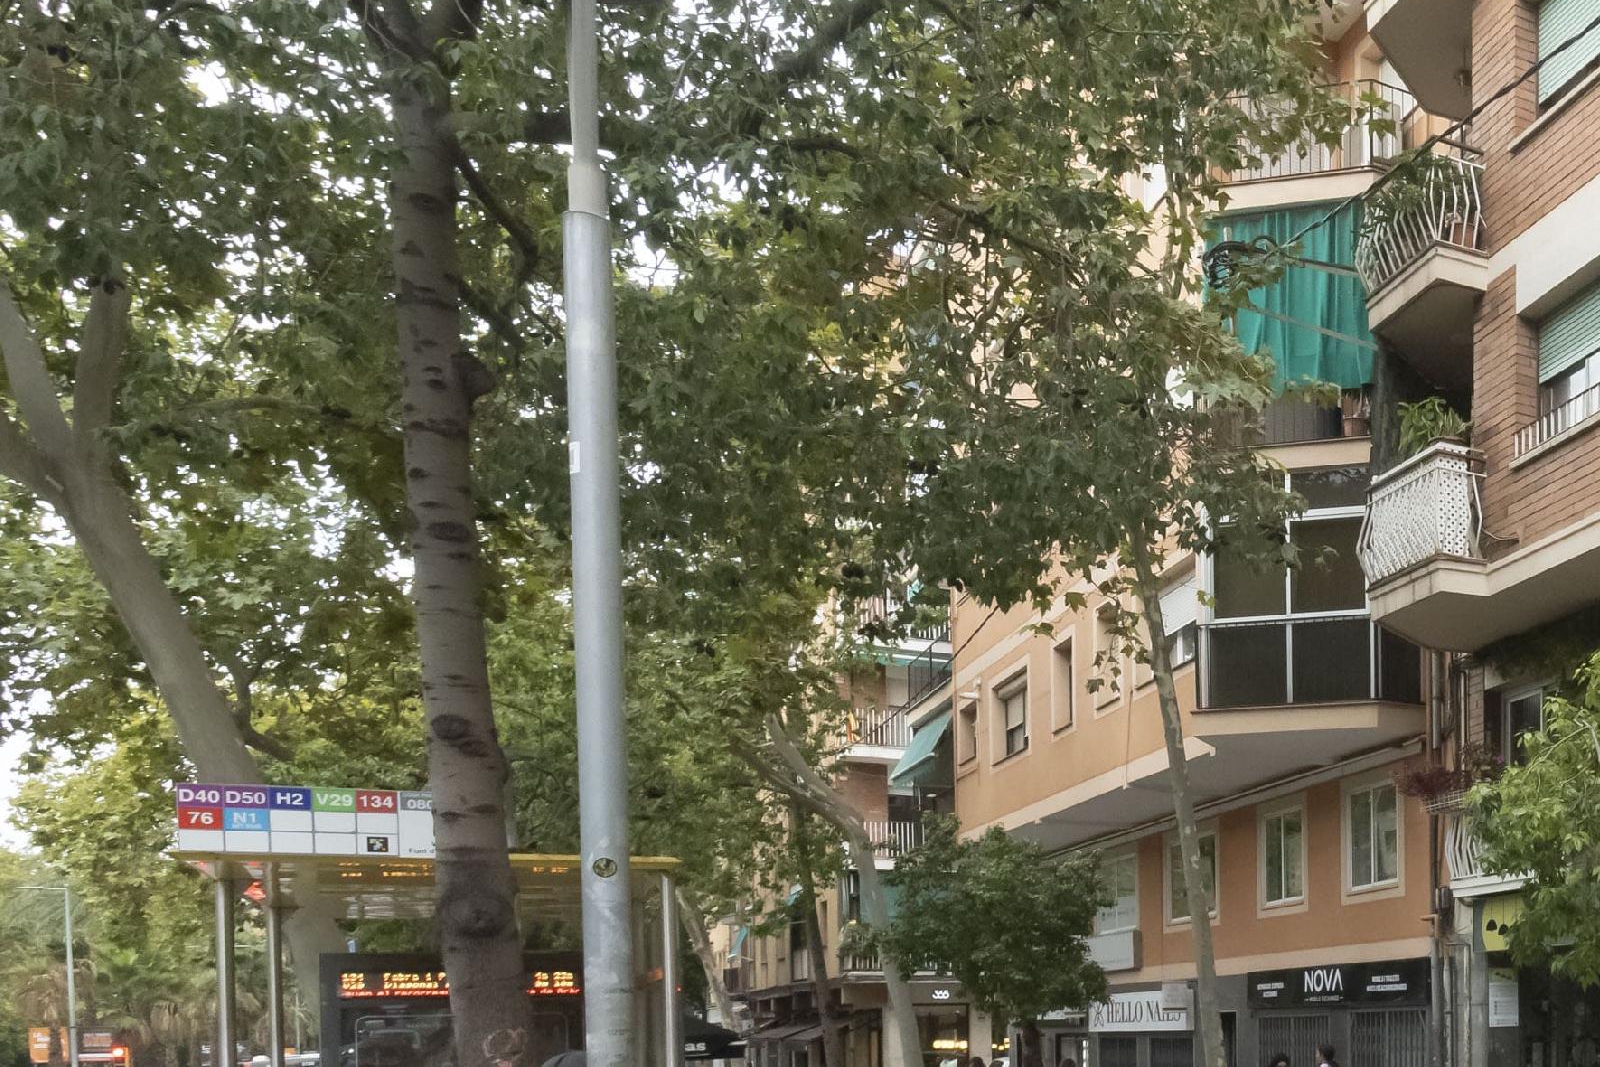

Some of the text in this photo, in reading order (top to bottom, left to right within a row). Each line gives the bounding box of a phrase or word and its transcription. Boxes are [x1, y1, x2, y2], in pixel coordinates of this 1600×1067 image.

[178, 790, 220, 804] D40
[225, 791, 266, 805] D50
[276, 793, 304, 806] H2
[317, 794, 354, 807] V29
[360, 795, 394, 809] 134
[187, 812, 214, 824] 76
[232, 812, 256, 824] N1
[1304, 968, 1344, 992] NOVA
[1106, 1000, 1144, 1023] HELLO
